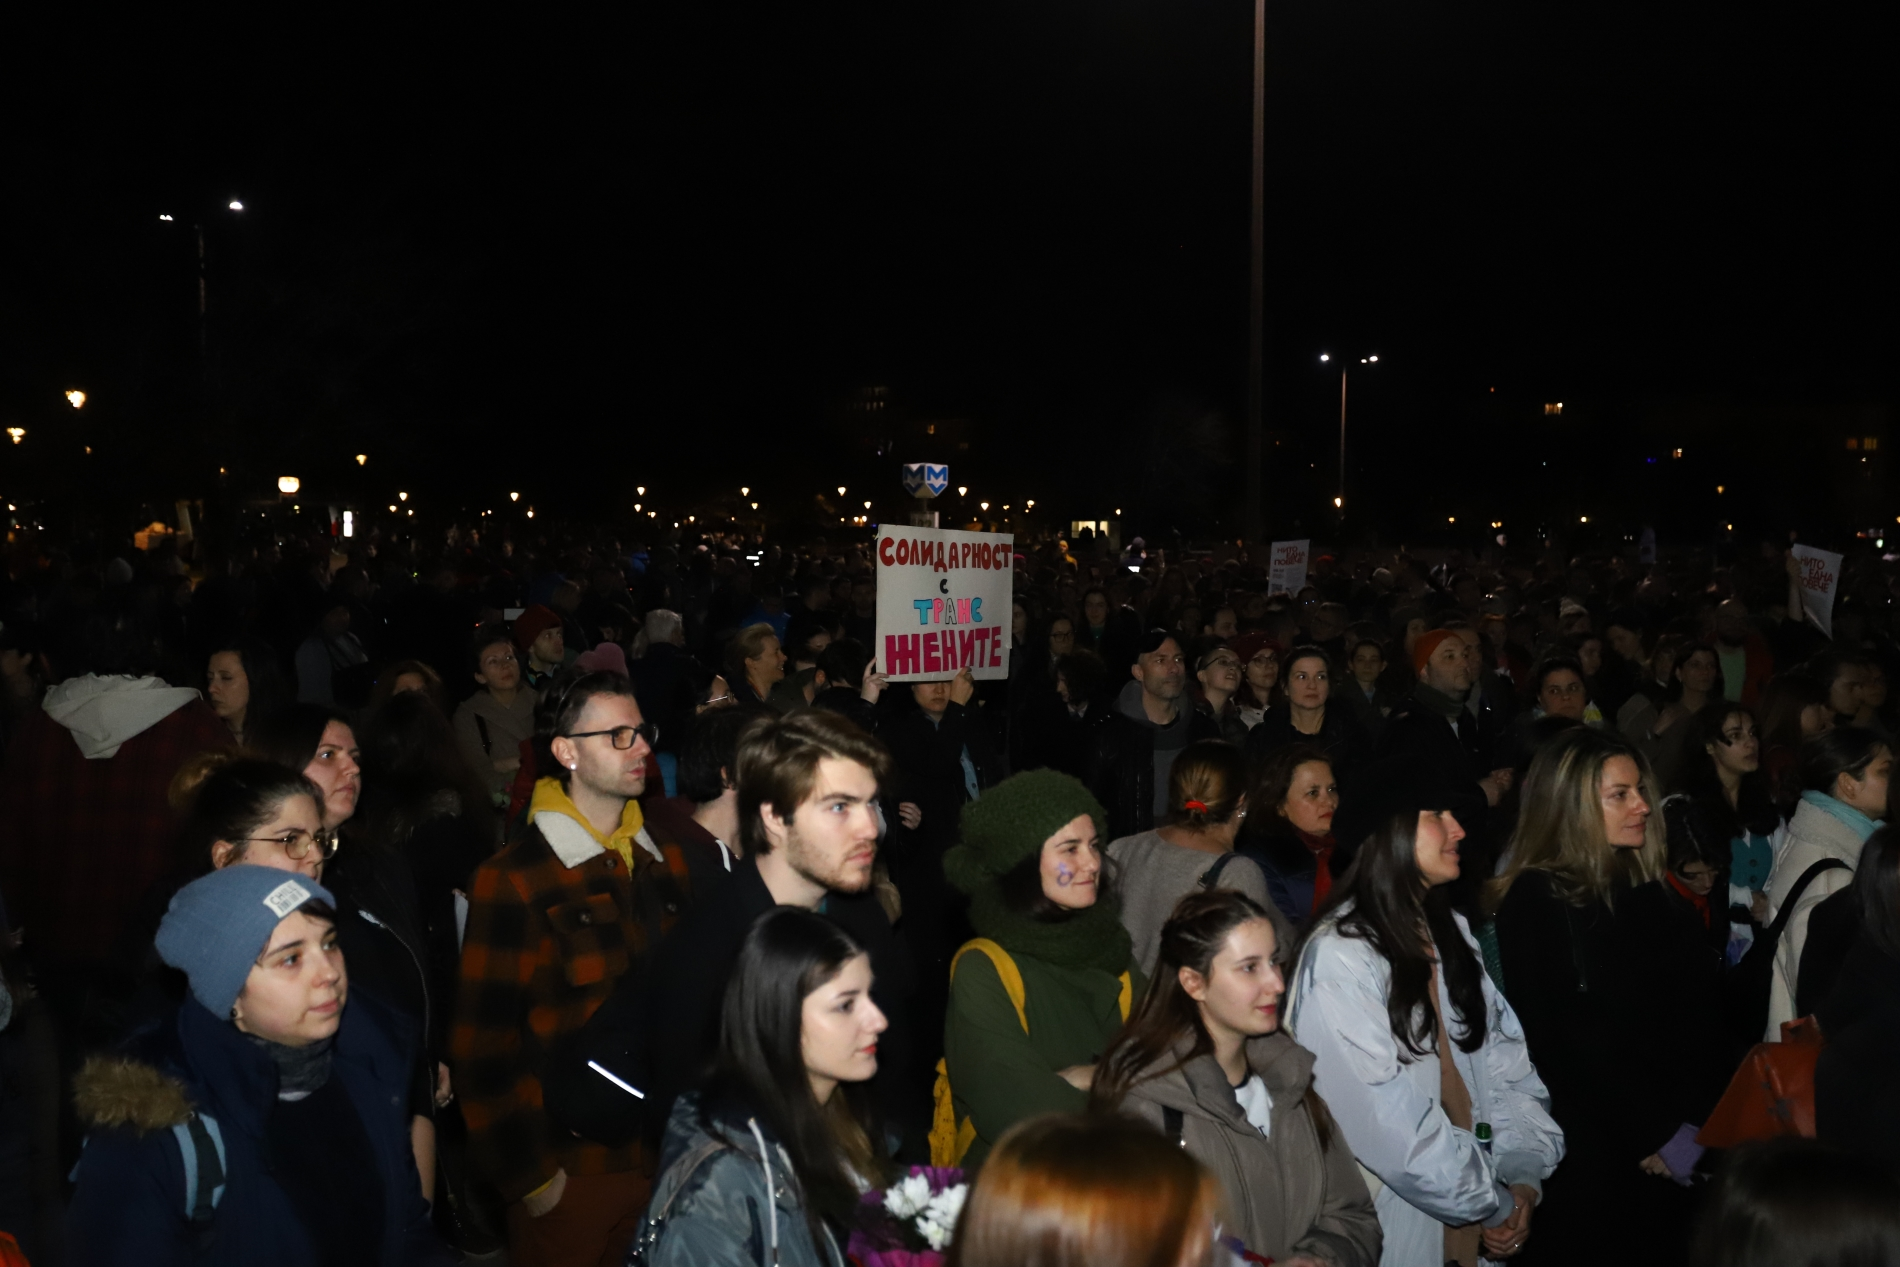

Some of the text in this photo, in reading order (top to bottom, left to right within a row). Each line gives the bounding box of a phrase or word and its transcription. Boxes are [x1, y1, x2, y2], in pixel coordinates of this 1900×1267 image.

[879, 537, 1012, 572] СОЛИДАРНОСТ
[1800, 556, 1825, 570] НИТО
[1809, 568, 1833, 583] ЕДНА
[913, 597, 983, 625] ТРАНС
[885, 626, 1002, 675] ЖЕНИТЕ
